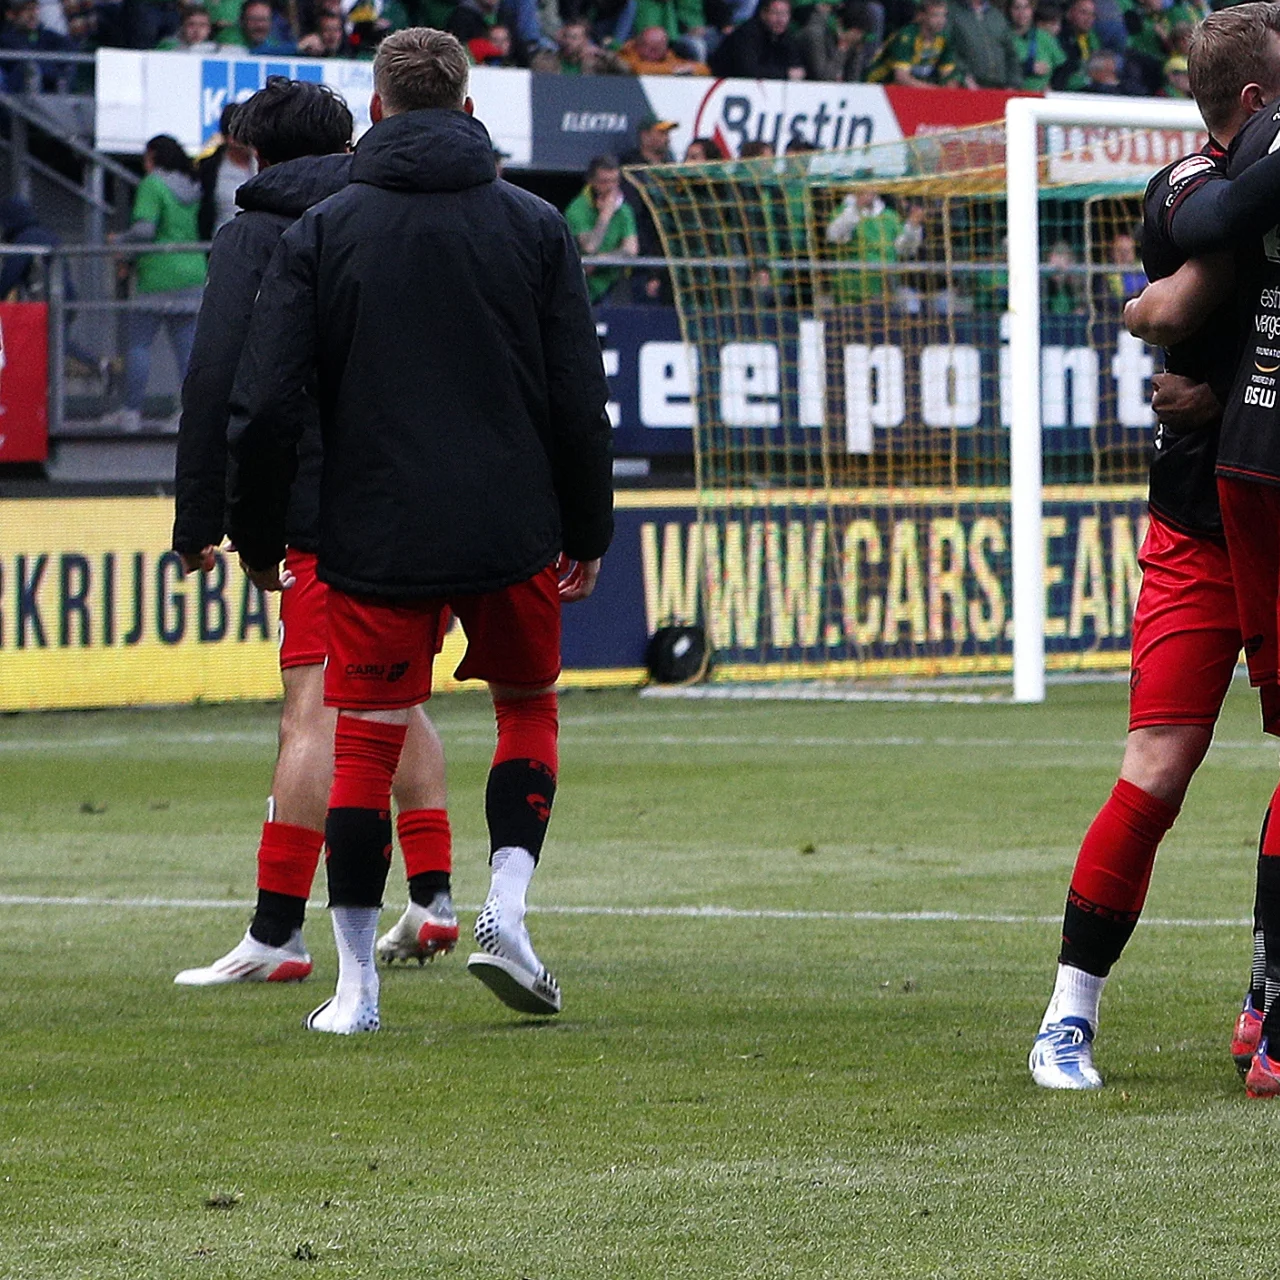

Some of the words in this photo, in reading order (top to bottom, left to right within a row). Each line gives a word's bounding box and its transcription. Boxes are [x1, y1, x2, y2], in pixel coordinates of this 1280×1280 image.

[1244, 385, 1277, 409] DSW
[0, 552, 271, 649] KRIJGBA
[640, 516, 1139, 650] WWW.CARSEAN
